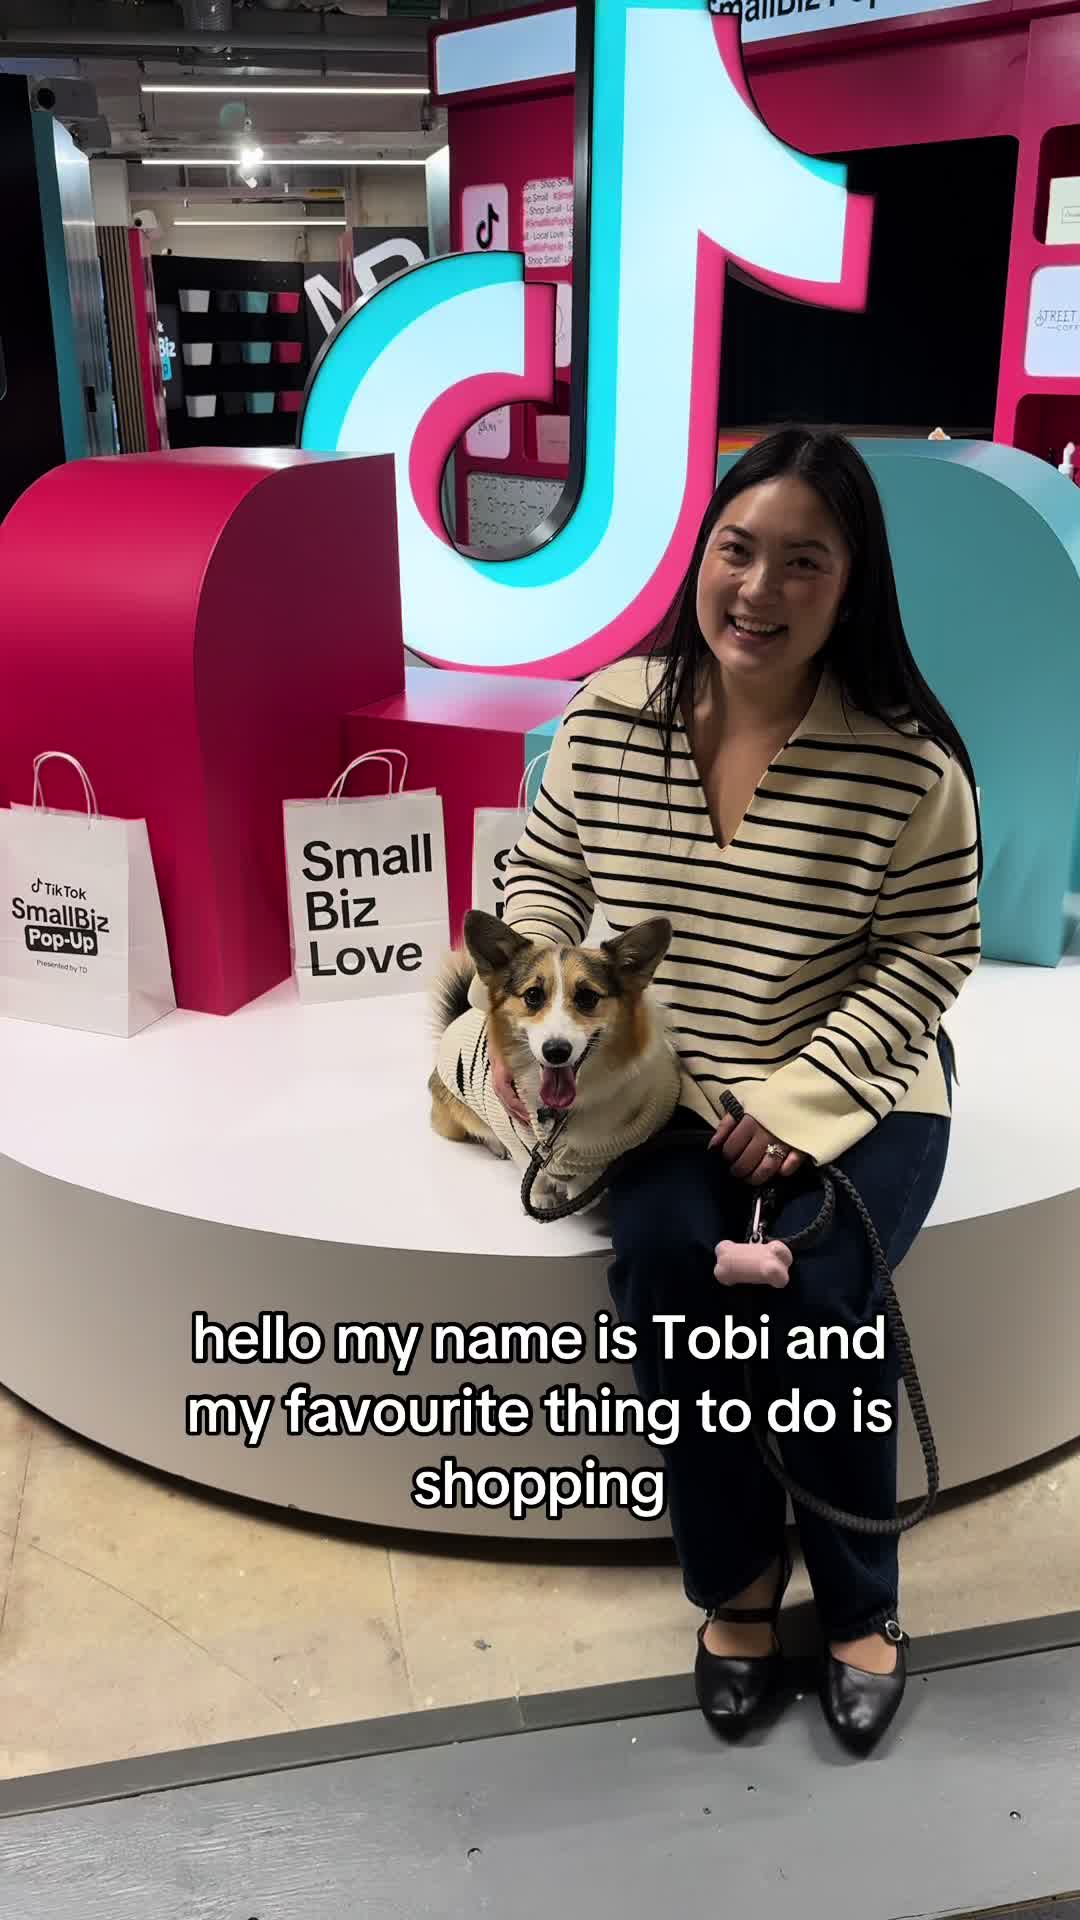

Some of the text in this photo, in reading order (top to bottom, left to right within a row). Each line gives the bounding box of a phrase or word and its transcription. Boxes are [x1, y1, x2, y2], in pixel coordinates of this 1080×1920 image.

[302, 833, 433, 882] Small
[45, 882, 87, 900] TikTok
[12, 897, 110, 933] SmallBiz
[306, 888, 379, 931] Biz
[28, 928, 95, 953] Pop-Up
[37, 960, 88, 974] Presented by TD
[309, 941, 423, 976] Love
